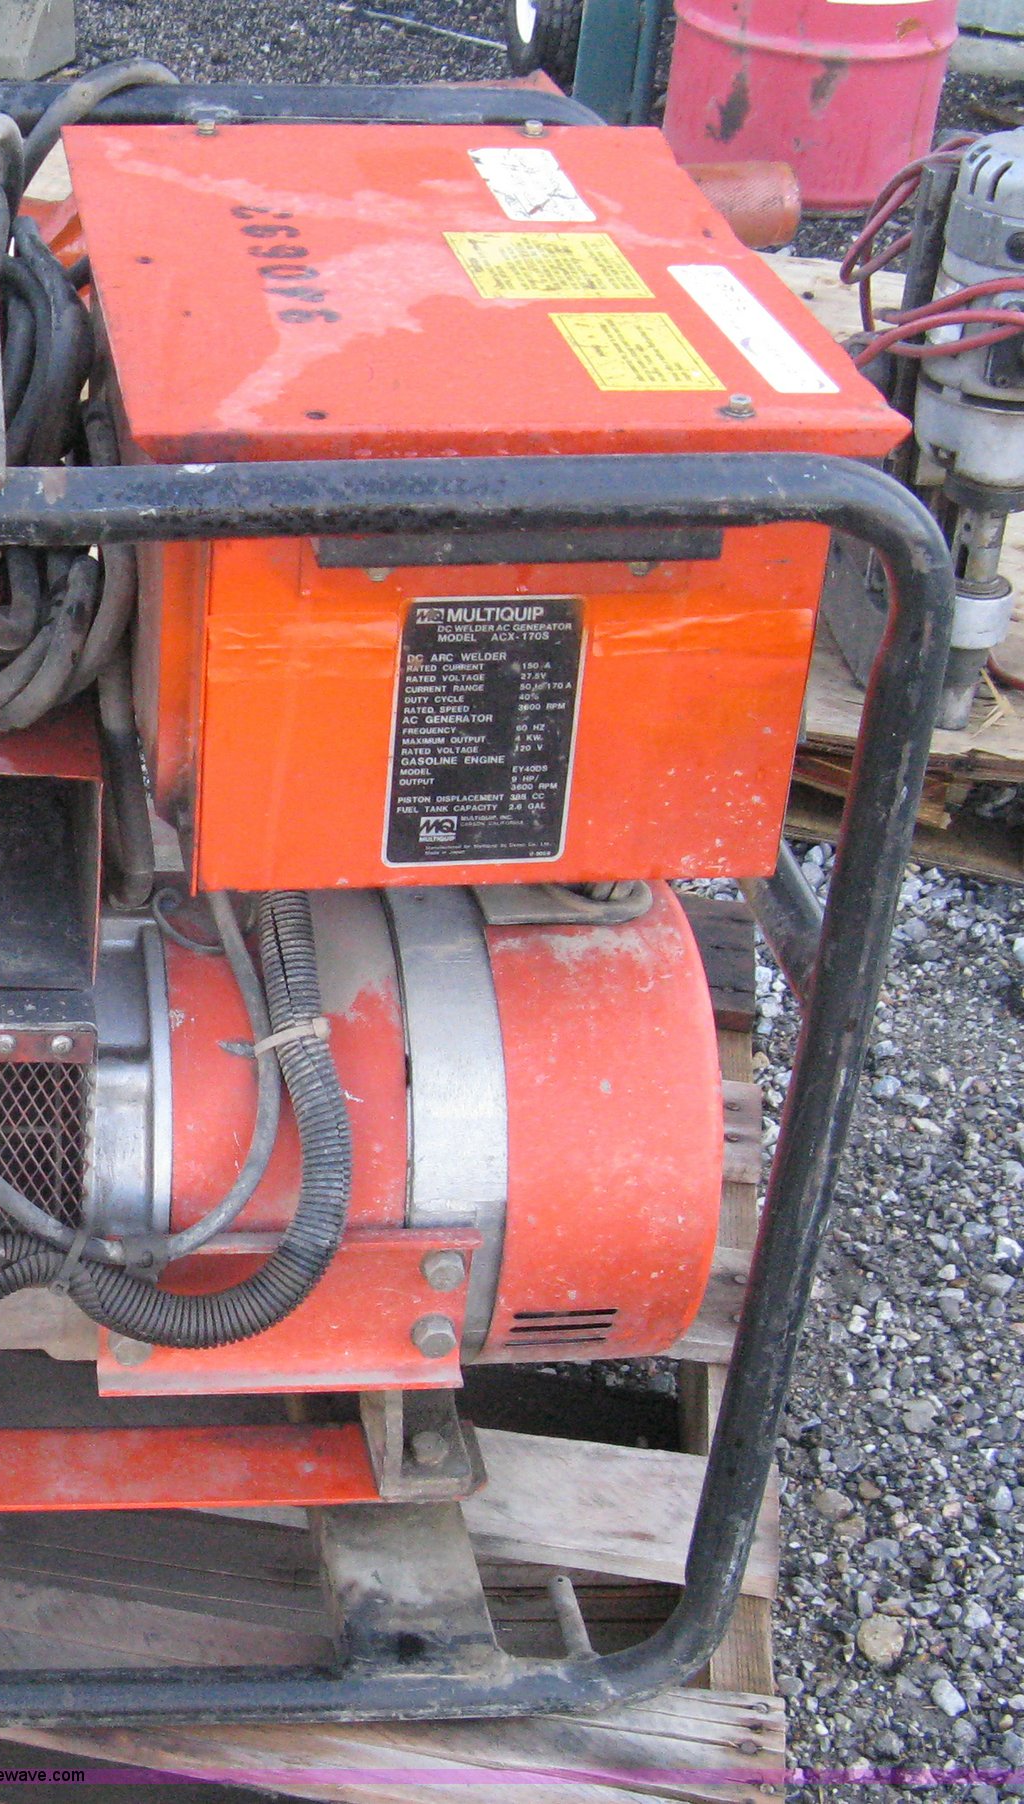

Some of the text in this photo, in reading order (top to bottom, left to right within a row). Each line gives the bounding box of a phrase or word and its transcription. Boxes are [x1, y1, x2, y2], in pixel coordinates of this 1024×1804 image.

[447, 607, 544, 623] MULTIQUIP
[437, 622, 572, 633] DC WELDER AC GENERATOR
[437, 631, 550, 642] MODEL ACX-170S
[407, 652, 507, 663] DC ARC WELDER
[406, 664, 437, 672] RATED
[442, 663, 485, 672] CURRENT
[406, 675, 436, 683] RATED
[442, 674, 486, 682] VOLTAGE
[405, 685, 446, 693] CURRENT
[453, 684, 485, 692] RANGE
[547, 682, 564, 690] 170
[404, 696, 429, 704] DUTY
[434, 695, 465, 703] CYCLE
[404, 702, 566, 714] RATED SPEED 3600 RPM
[402, 714, 493, 724] AC GENERATOR
[402, 727, 456, 735] FREQUENCY
[402, 737, 446, 745] MAXIMUM
[450, 735, 486, 744] OUTPUT
[401, 747, 431, 756] RATED
[437, 746, 479, 754] VOLTAGE
[514, 744, 531, 752] 120
[401, 755, 506, 766] GASOLINE ENGINE
[400, 768, 432, 776] MODEL
[399, 778, 435, 786] OUTPUT
[522, 774, 540, 782] HP/
[511, 782, 558, 791] 3600 RPM
[397, 796, 431, 804] PISTON
[436, 793, 505, 802] DISPLACEMENT
[531, 792, 545, 800] CC
[396, 806, 419, 814] FUEL
[424, 805, 449, 813] TANK
[453, 804, 498, 812] CAPACITY
[527, 802, 546, 810] GAL
[419, 816, 458, 836] MQ
